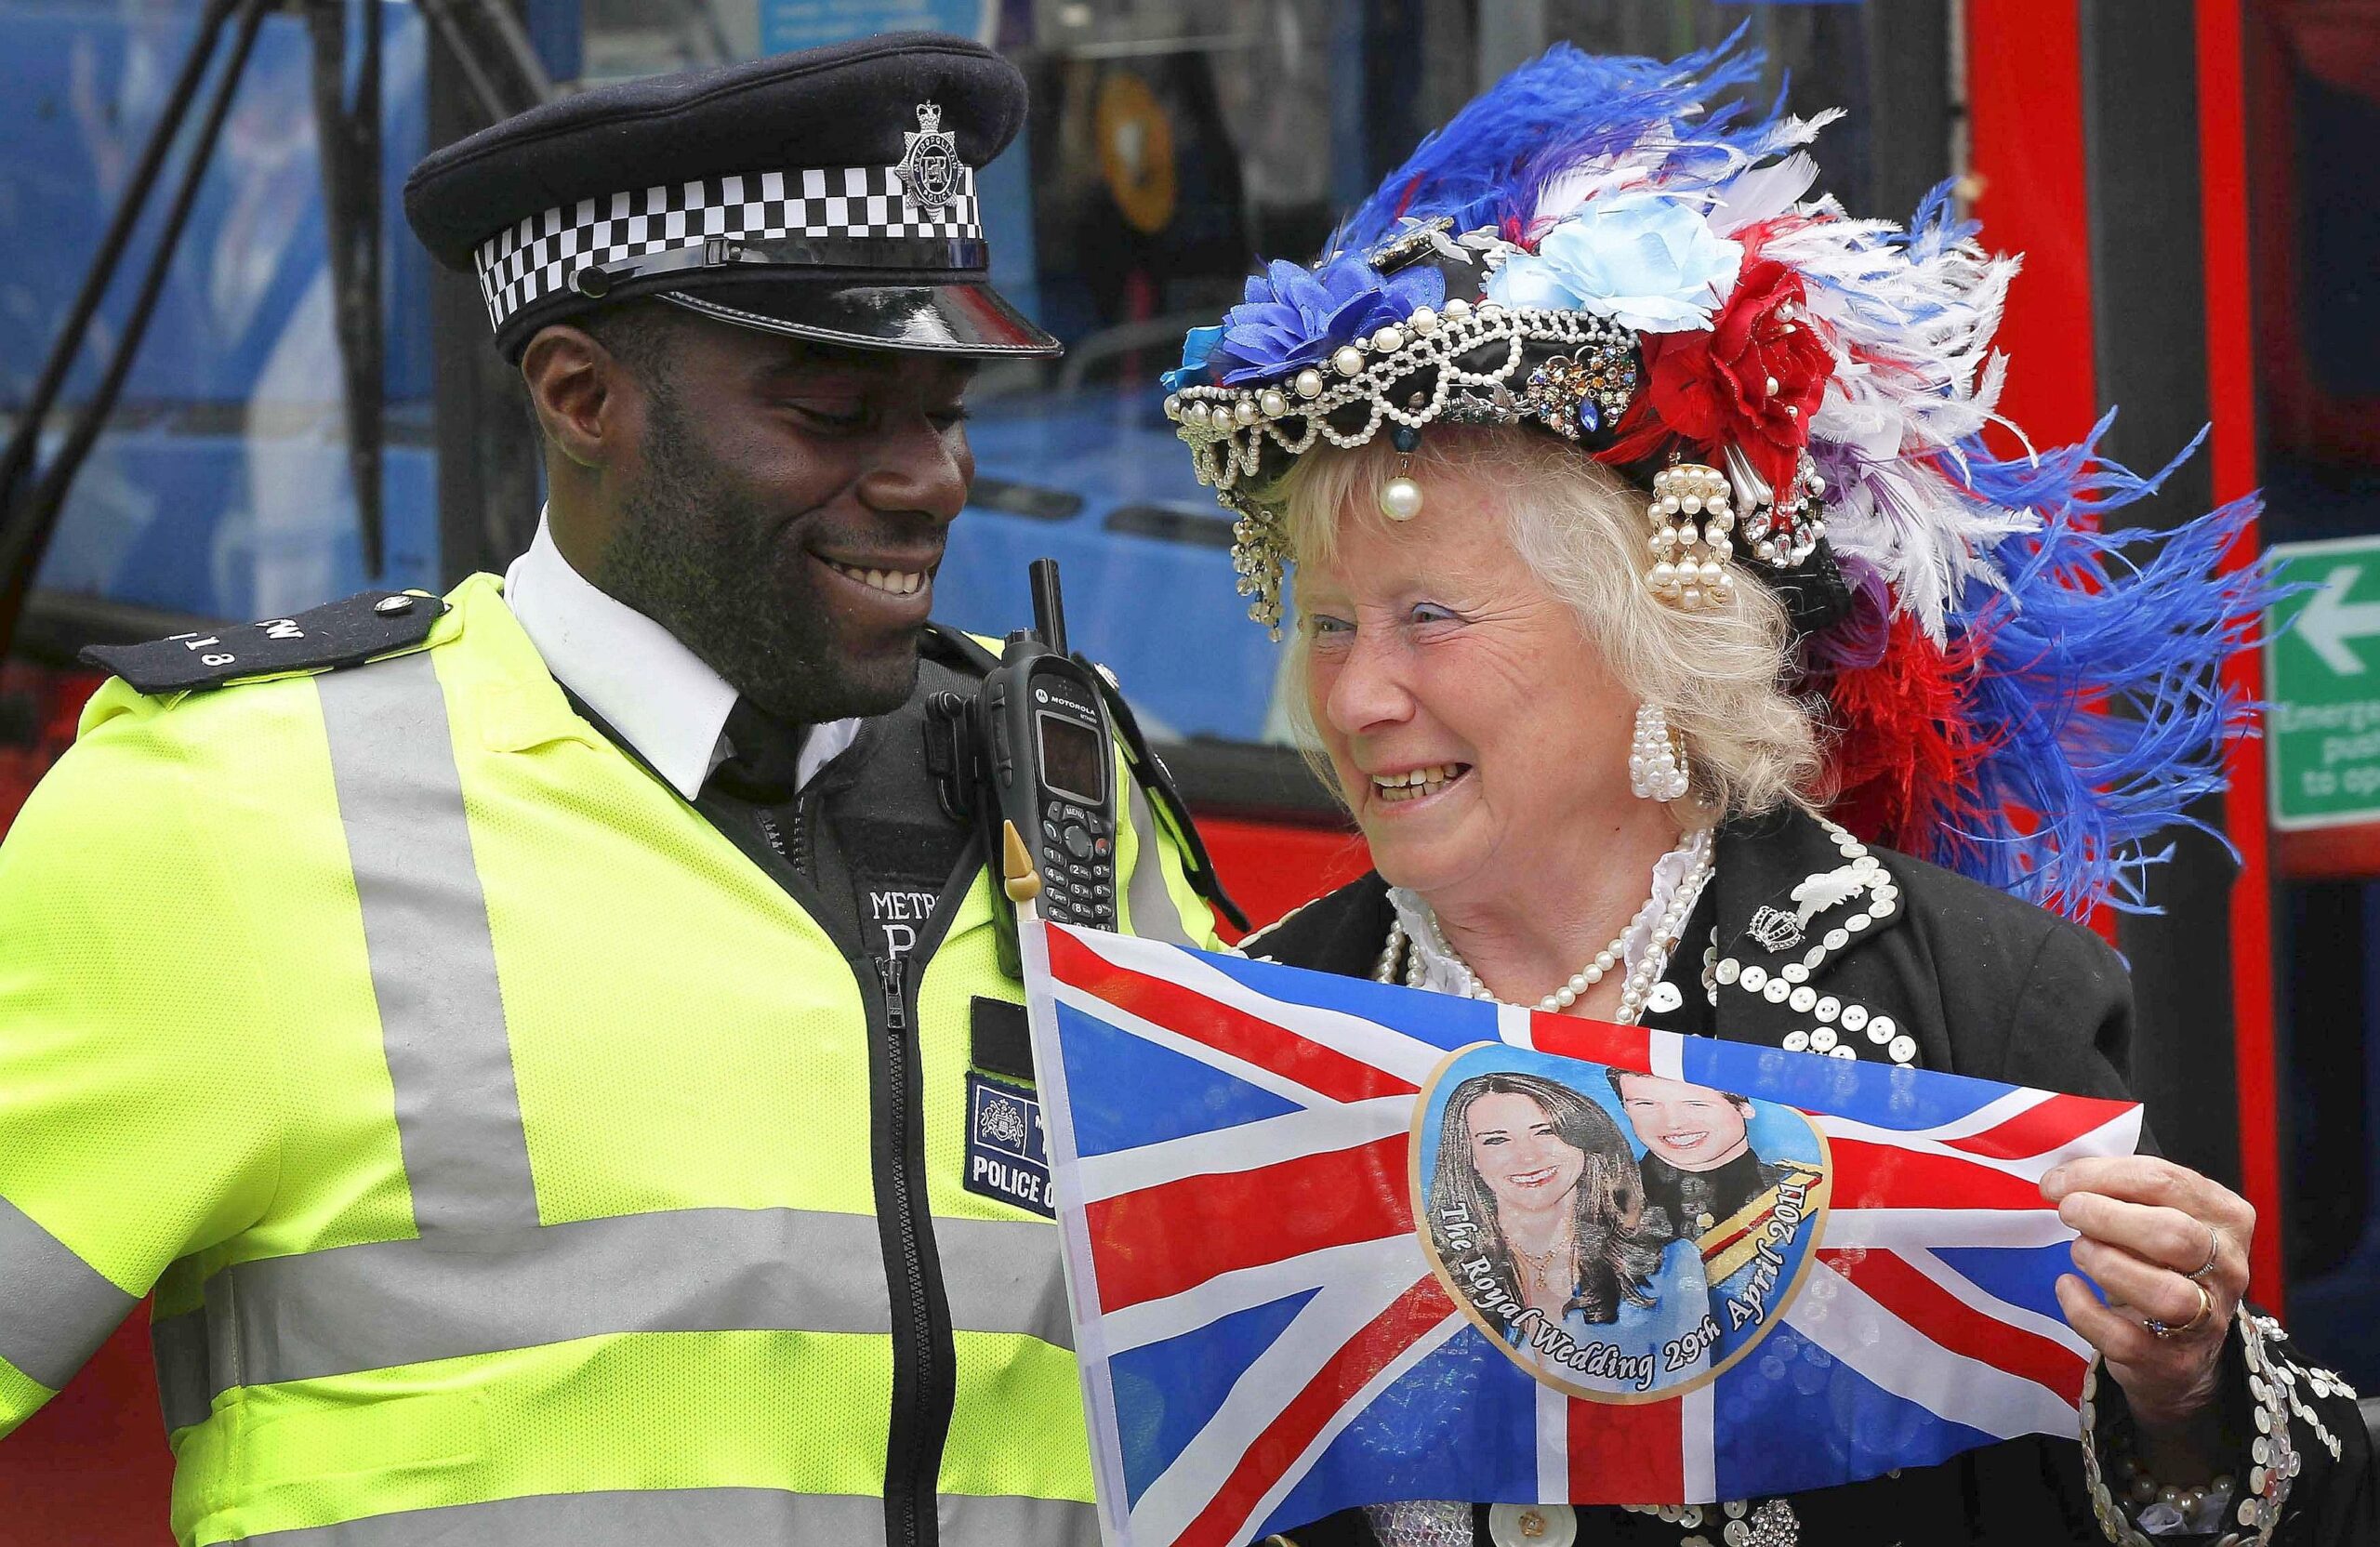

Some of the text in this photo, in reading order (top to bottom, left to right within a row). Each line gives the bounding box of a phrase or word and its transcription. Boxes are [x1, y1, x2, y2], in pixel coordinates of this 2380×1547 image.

[914, 137, 958, 173] METROPOLITAN
[923, 189, 952, 203] POLICE
[1051, 695, 1096, 716] MOTOROLA
[1065, 808, 1085, 819] MENU
[1049, 850, 1054, 859] 1
[1048, 868, 1054, 878] 4
[1073, 865, 1079, 874] 2
[1096, 866, 1102, 875] 3
[1048, 887, 1055, 897] 7
[1074, 884, 1080, 893] 5
[1096, 885, 1103, 894] 6
[869, 892, 940, 919] METR
[1075, 903, 1081, 912] 8
[1097, 905, 1103, 914] 9
[972, 1155, 1040, 1203] POLICE
[1440, 1181, 1806, 1392] The Royal Wedding 29th April 2011
